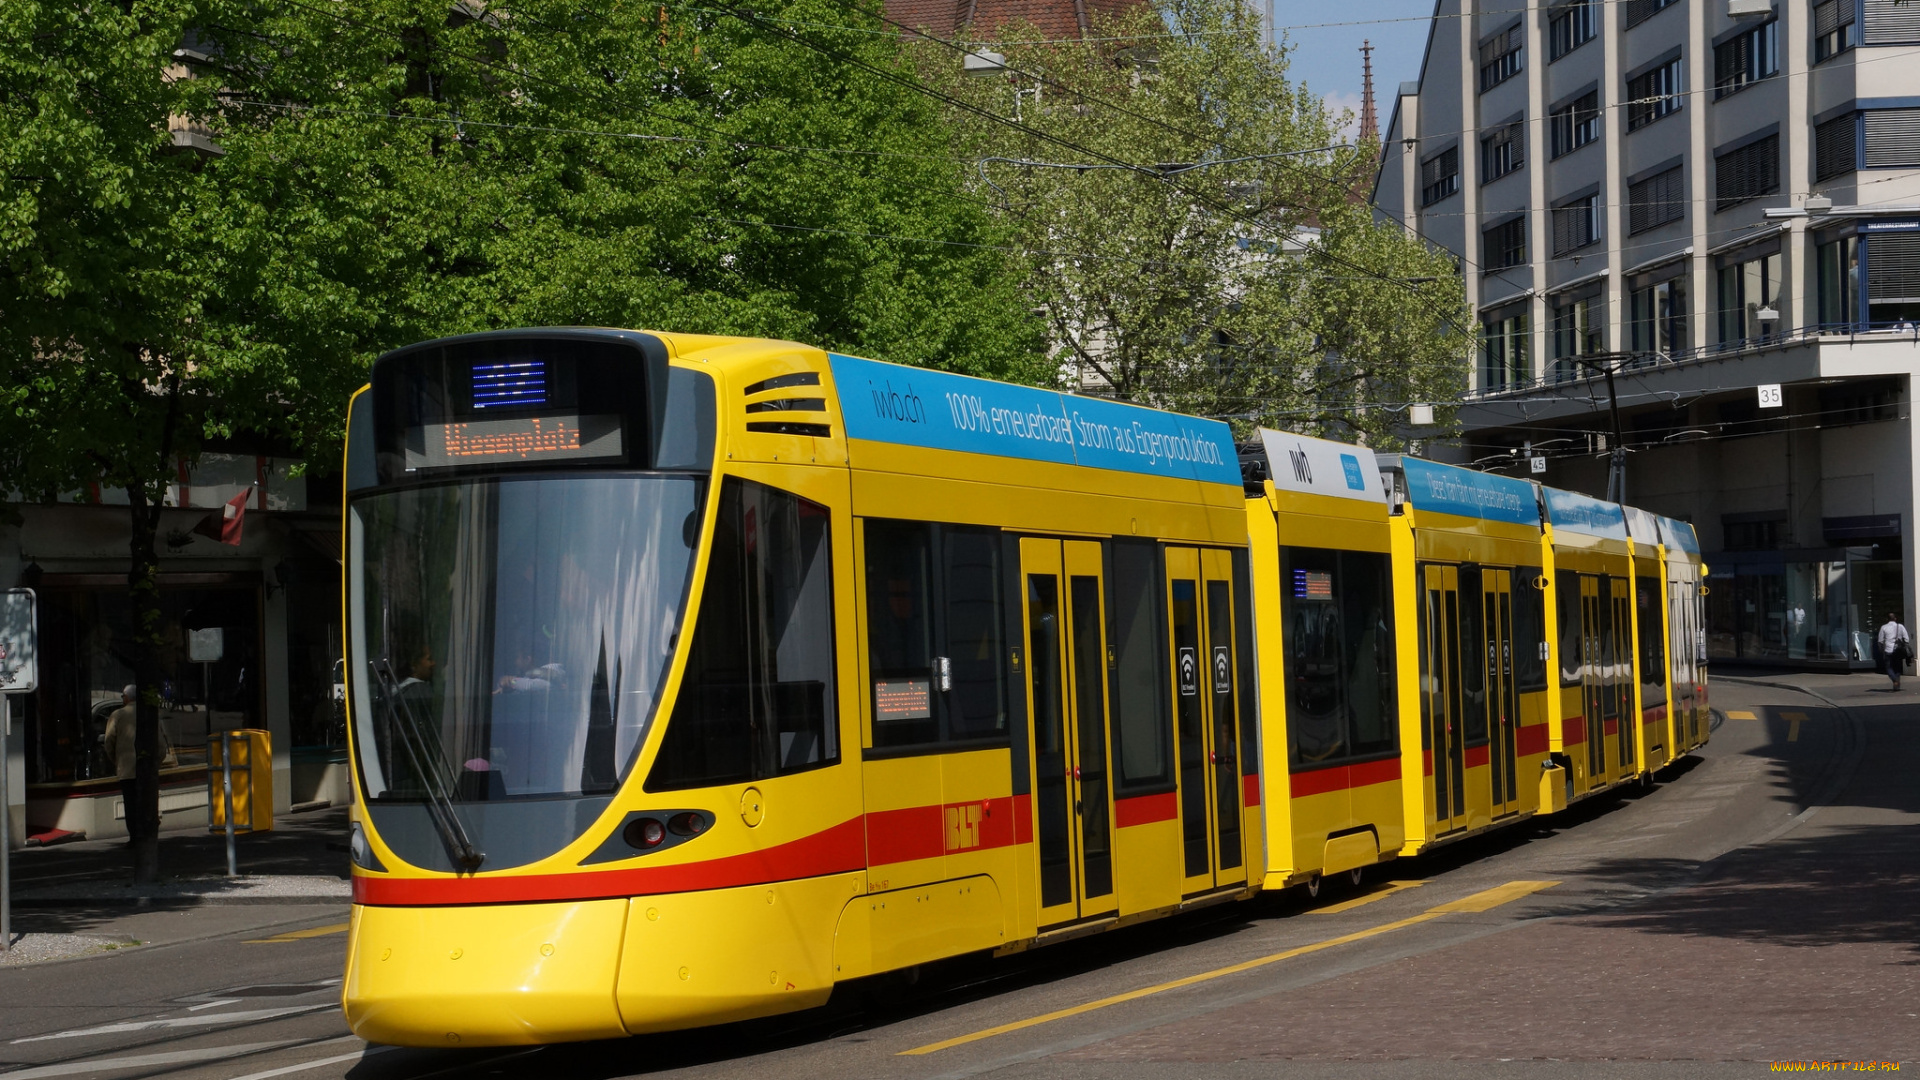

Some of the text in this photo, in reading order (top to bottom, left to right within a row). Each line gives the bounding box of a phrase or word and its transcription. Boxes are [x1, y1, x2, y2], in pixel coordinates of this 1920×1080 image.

[869, 380, 926, 424] iwb.ch
[1761, 389, 1780, 403] 35
[946, 393, 1224, 467] 100% erneuerbarer Strom aus Eigenproduktion.
[1533, 459, 1544, 470] 45
[945, 804, 982, 850] BLT
